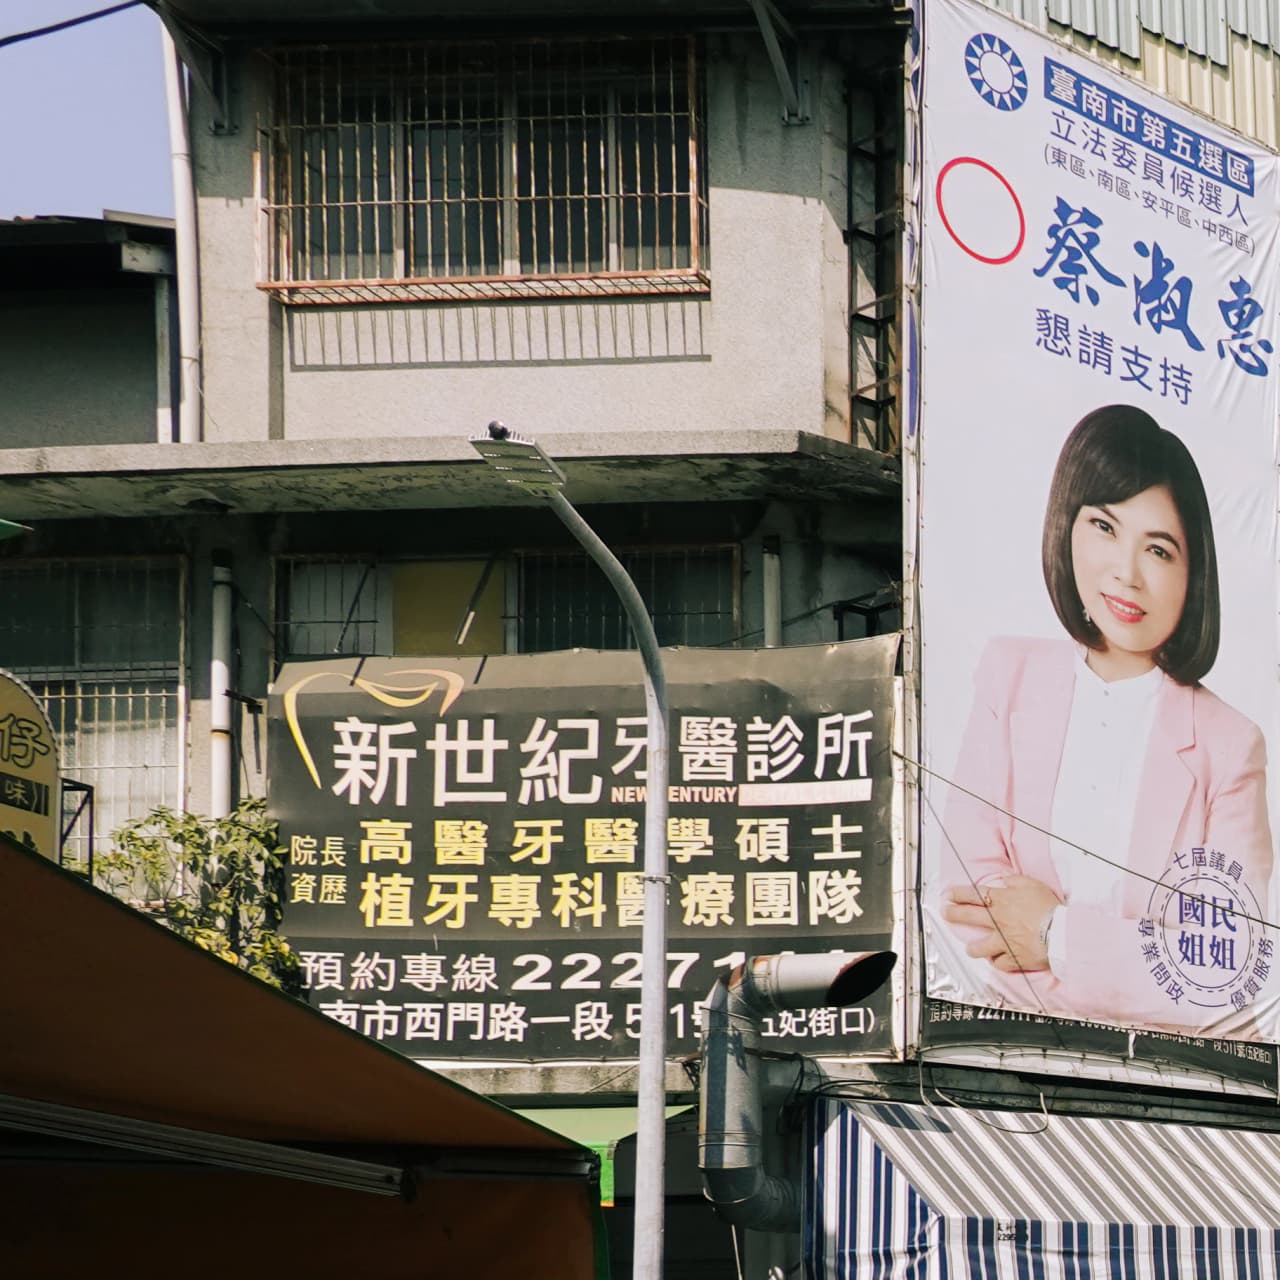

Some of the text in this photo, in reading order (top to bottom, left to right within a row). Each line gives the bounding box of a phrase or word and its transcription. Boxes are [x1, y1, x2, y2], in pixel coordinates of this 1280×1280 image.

[1048, 64, 1252, 190] 臺南市第五選區
[1050, 109, 1250, 227] 立法委員候選人
[1032, 196, 1274, 377] 蔡淑惠
[1035, 307, 1194, 406] 懇請支持
[668, 786, 737, 803] ENTURY
[290, 835, 346, 867] 院長
[360, 814, 863, 866] 高醫牙醫學碩士
[290, 872, 346, 904] 資歷
[1173, 848, 1243, 883] 七屆議員
[359, 870, 863, 929] 植牙專科醫療團隊
[1178, 892, 1236, 932] 國民
[299, 950, 499, 992] 預約專線
[1138, 917, 1184, 1005] 專業問政
[1178, 931, 1236, 970] 姐姐
[1230, 937, 1274, 1011] 優質服務
[761, 1006, 876, 1039] 妃街口)
